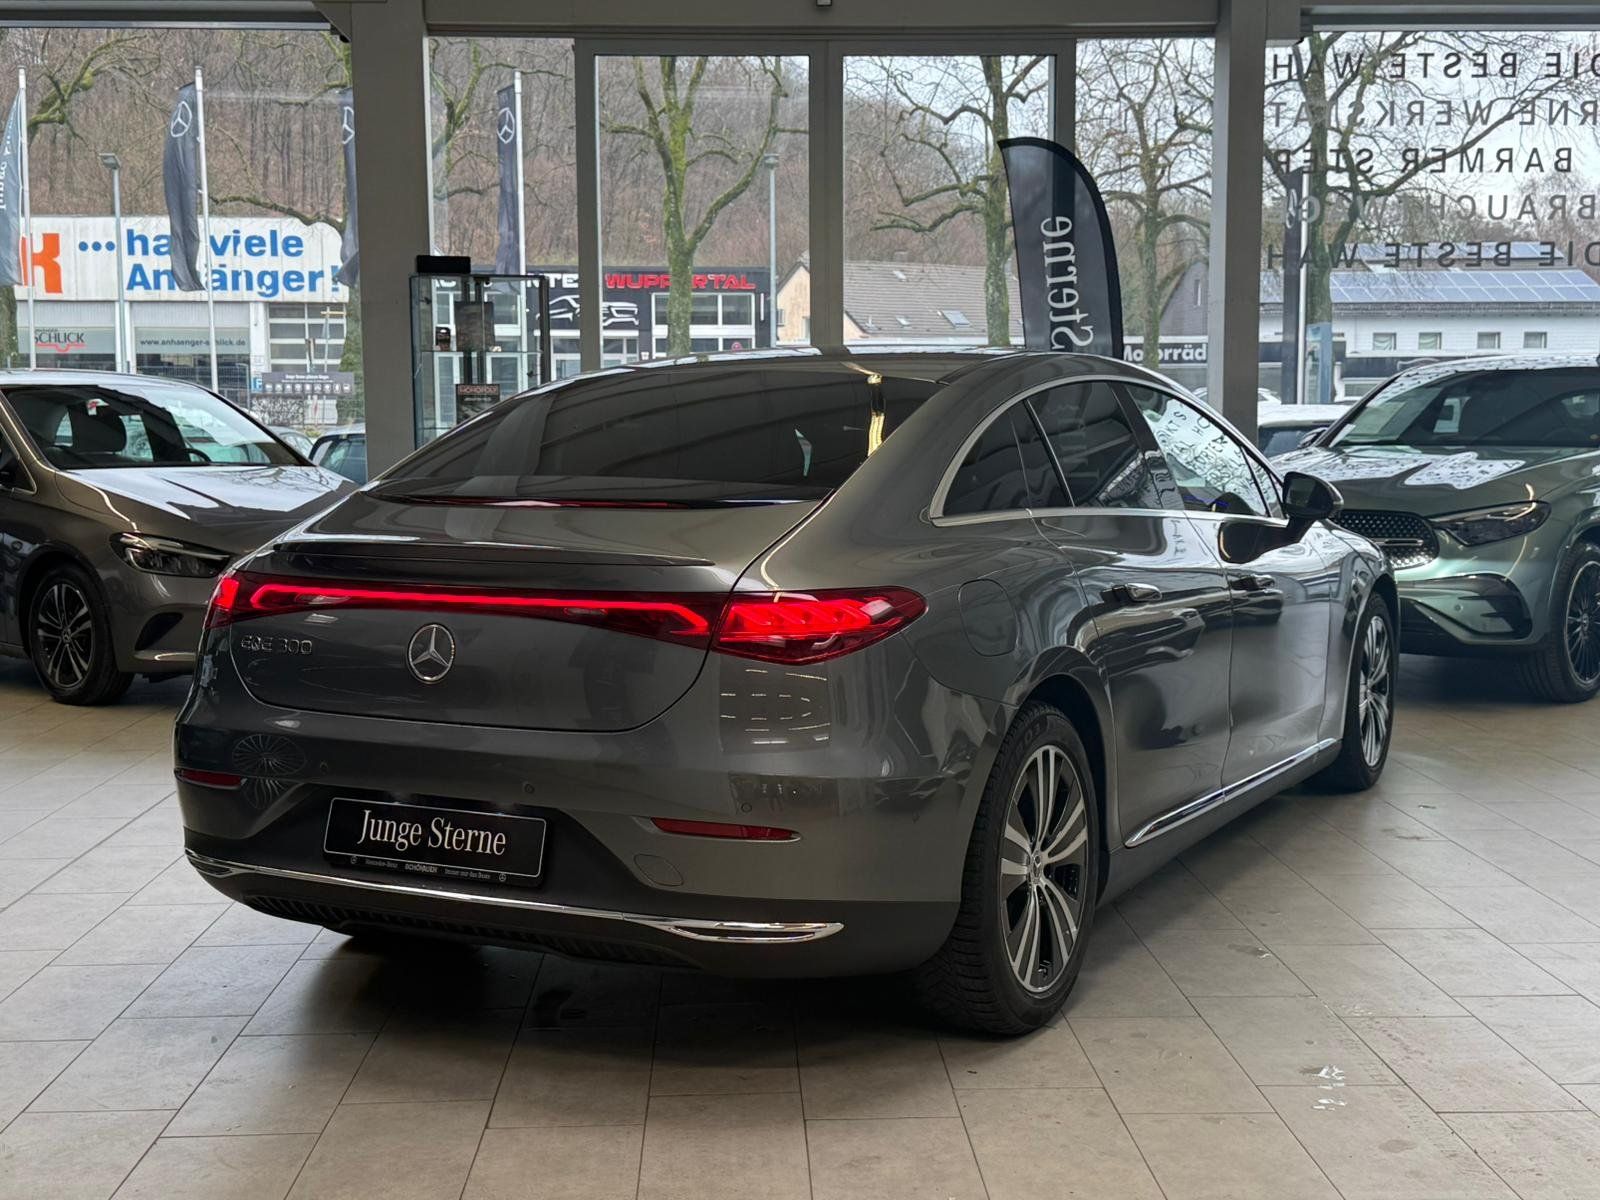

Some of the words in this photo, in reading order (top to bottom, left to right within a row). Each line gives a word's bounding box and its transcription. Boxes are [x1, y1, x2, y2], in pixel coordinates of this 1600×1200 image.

[126, 228, 172, 257] ha
[209, 229, 304, 258] viele
[126, 264, 342, 298] Anänger!
[604, 273, 756, 289] WUPPRTAL
[278, 637, 313, 655] 300
[357, 809, 422, 852] Junge
[427, 816, 507, 856] Sterne
